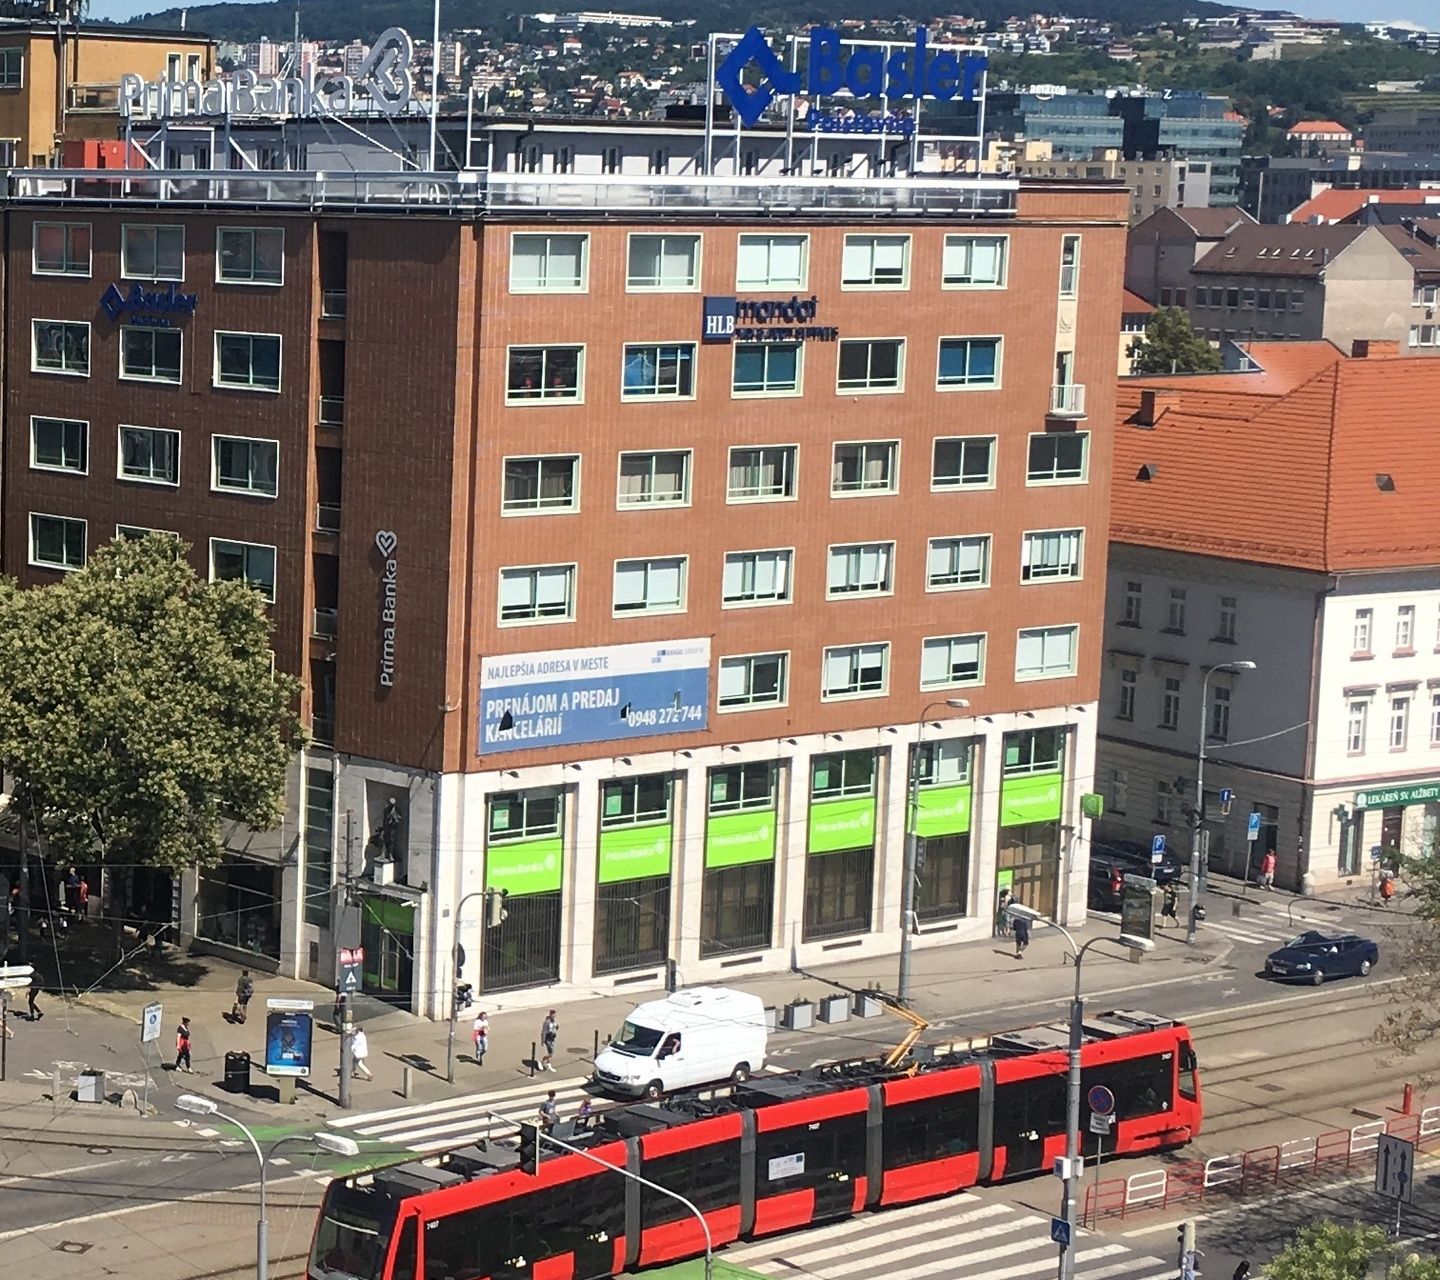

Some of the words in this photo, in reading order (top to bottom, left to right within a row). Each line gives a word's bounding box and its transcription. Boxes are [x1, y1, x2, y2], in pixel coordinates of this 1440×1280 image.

[809, 26, 988, 102] Basler
[706, 315, 735, 334] HLB
[382, 559, 397, 623] Banka
[380, 627, 396, 687] Prima
[487, 662, 535, 680] NAJLEPŠIA
[536, 659, 571, 676] ADRESA
[572, 658, 579, 671] V
[580, 656, 609, 672] MESTE
[486, 692, 557, 720] PRENÁJOM
[560, 692, 569, 711] A
[571, 687, 620, 711] PREDAJ
[628, 708, 657, 728] 0948
[681, 704, 702, 721] 744
